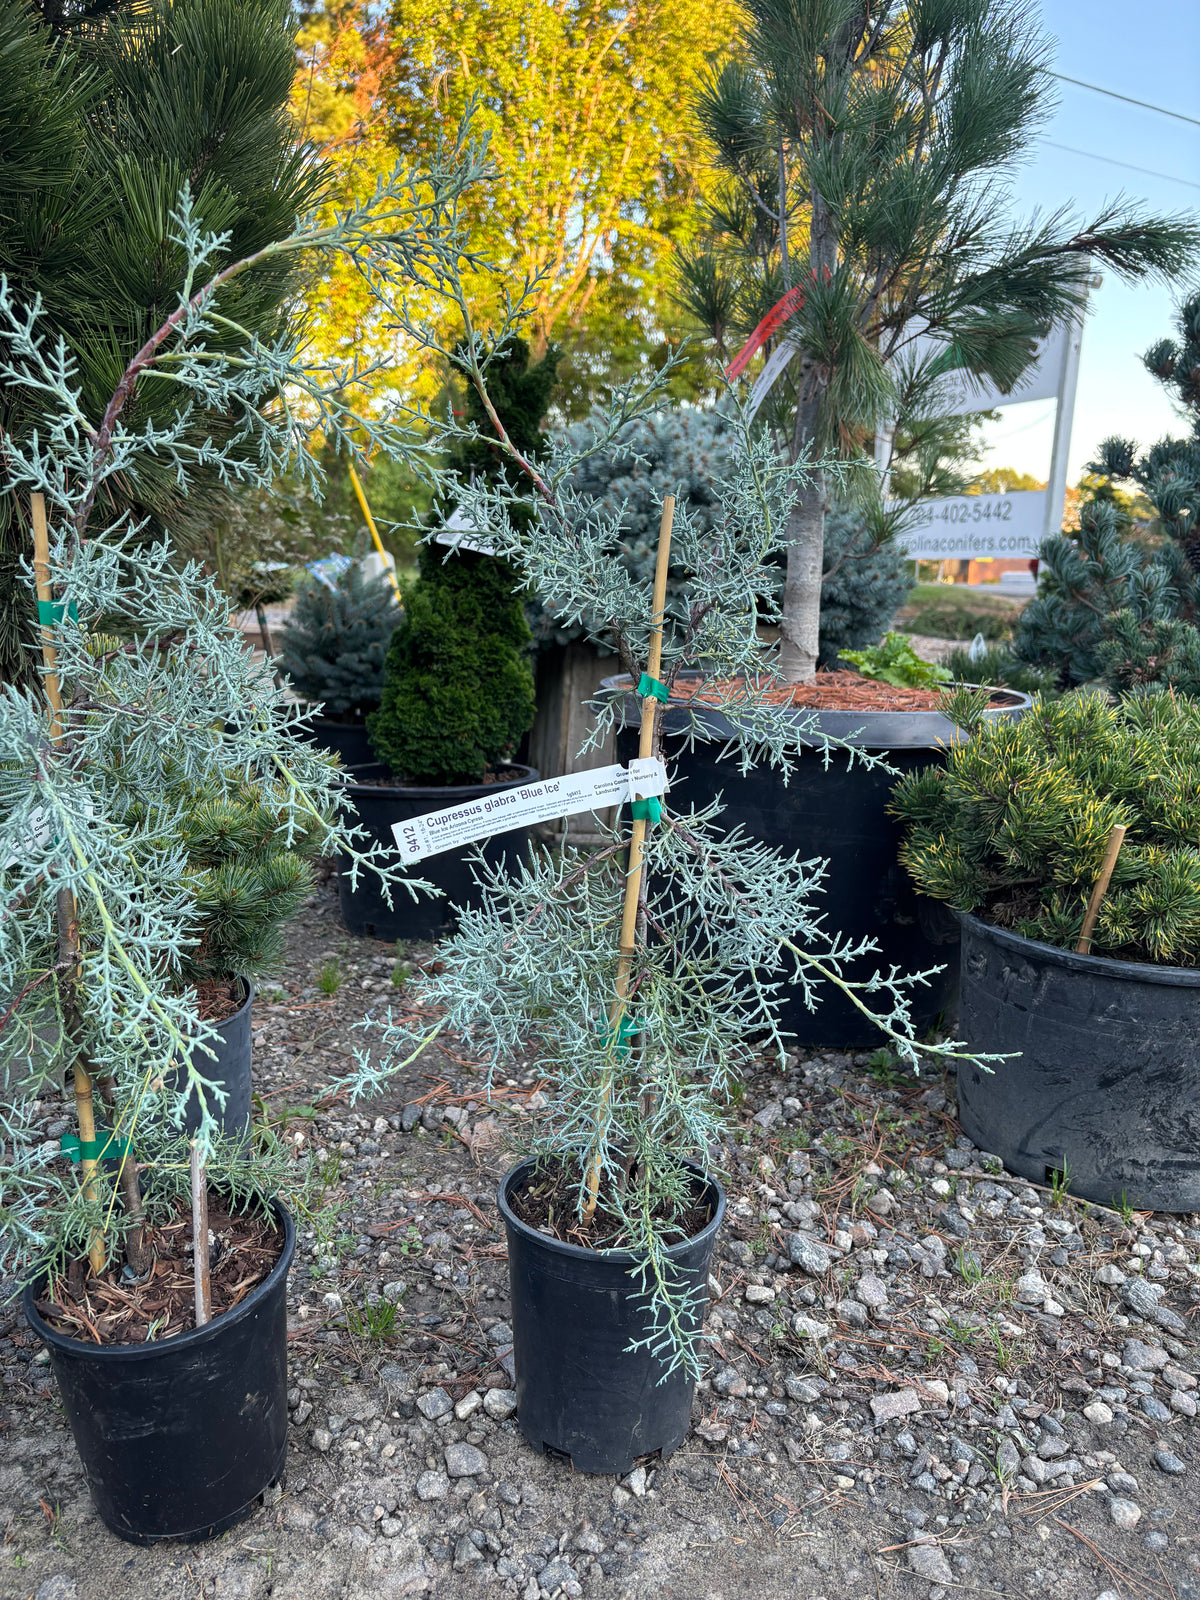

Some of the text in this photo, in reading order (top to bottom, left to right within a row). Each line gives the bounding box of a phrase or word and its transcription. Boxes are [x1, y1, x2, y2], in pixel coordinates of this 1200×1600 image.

[594, 781, 613, 789] Carolina
[595, 786, 620, 795] Landscape
[426, 781, 560, 828] Cupressus glabra 'Blue Ice'
[402, 826, 420, 853] 9412
